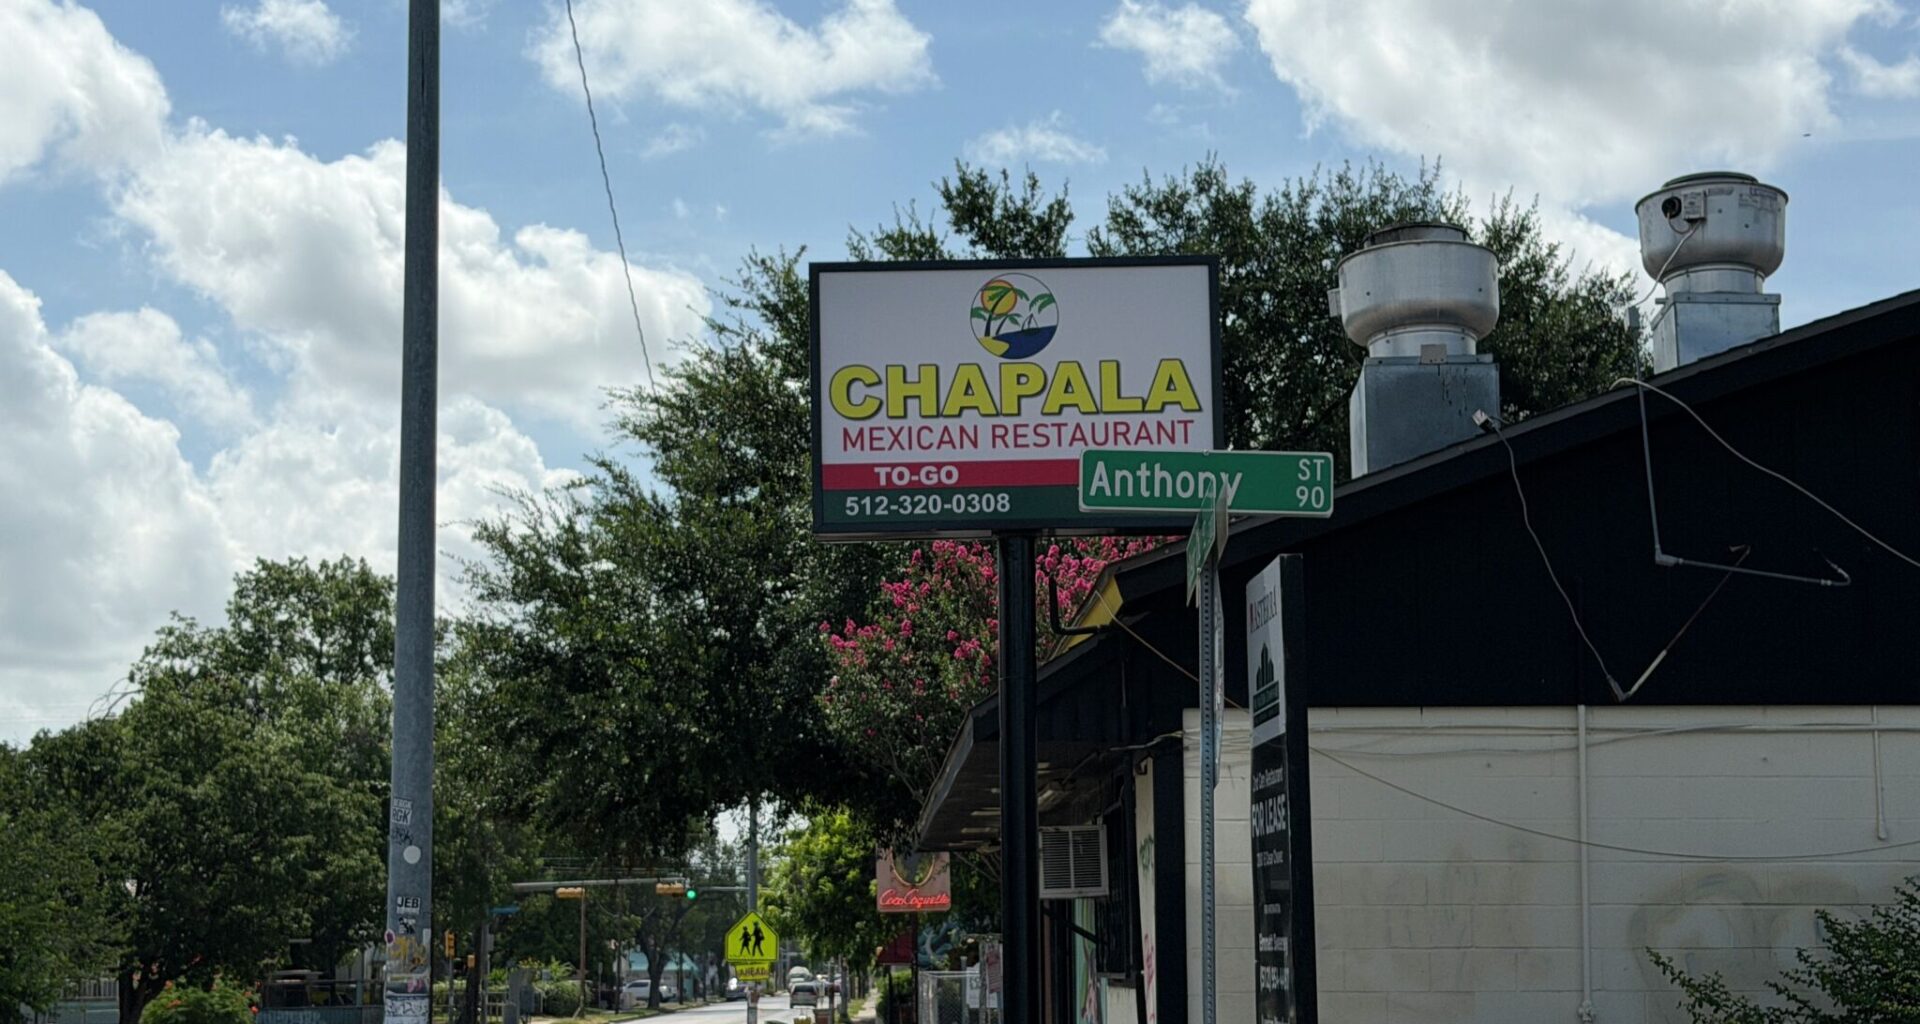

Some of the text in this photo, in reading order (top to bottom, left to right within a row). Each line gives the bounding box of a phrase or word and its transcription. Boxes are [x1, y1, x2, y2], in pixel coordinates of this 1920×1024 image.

[829, 358, 1202, 421] CHAPALA
[842, 419, 1195, 452] MEXICAN RESTAURANT
[874, 464, 959, 486] TO-GO
[1297, 458, 1325, 481] ST
[1089, 460, 1243, 507] Anthony
[845, 493, 1011, 516] 512-320-0308
[1296, 485, 1325, 509] 90
[1252, 793, 1286, 838] FOR LEASE
[397, 896, 419, 908] JEB
[739, 967, 768, 977] AHEAD
